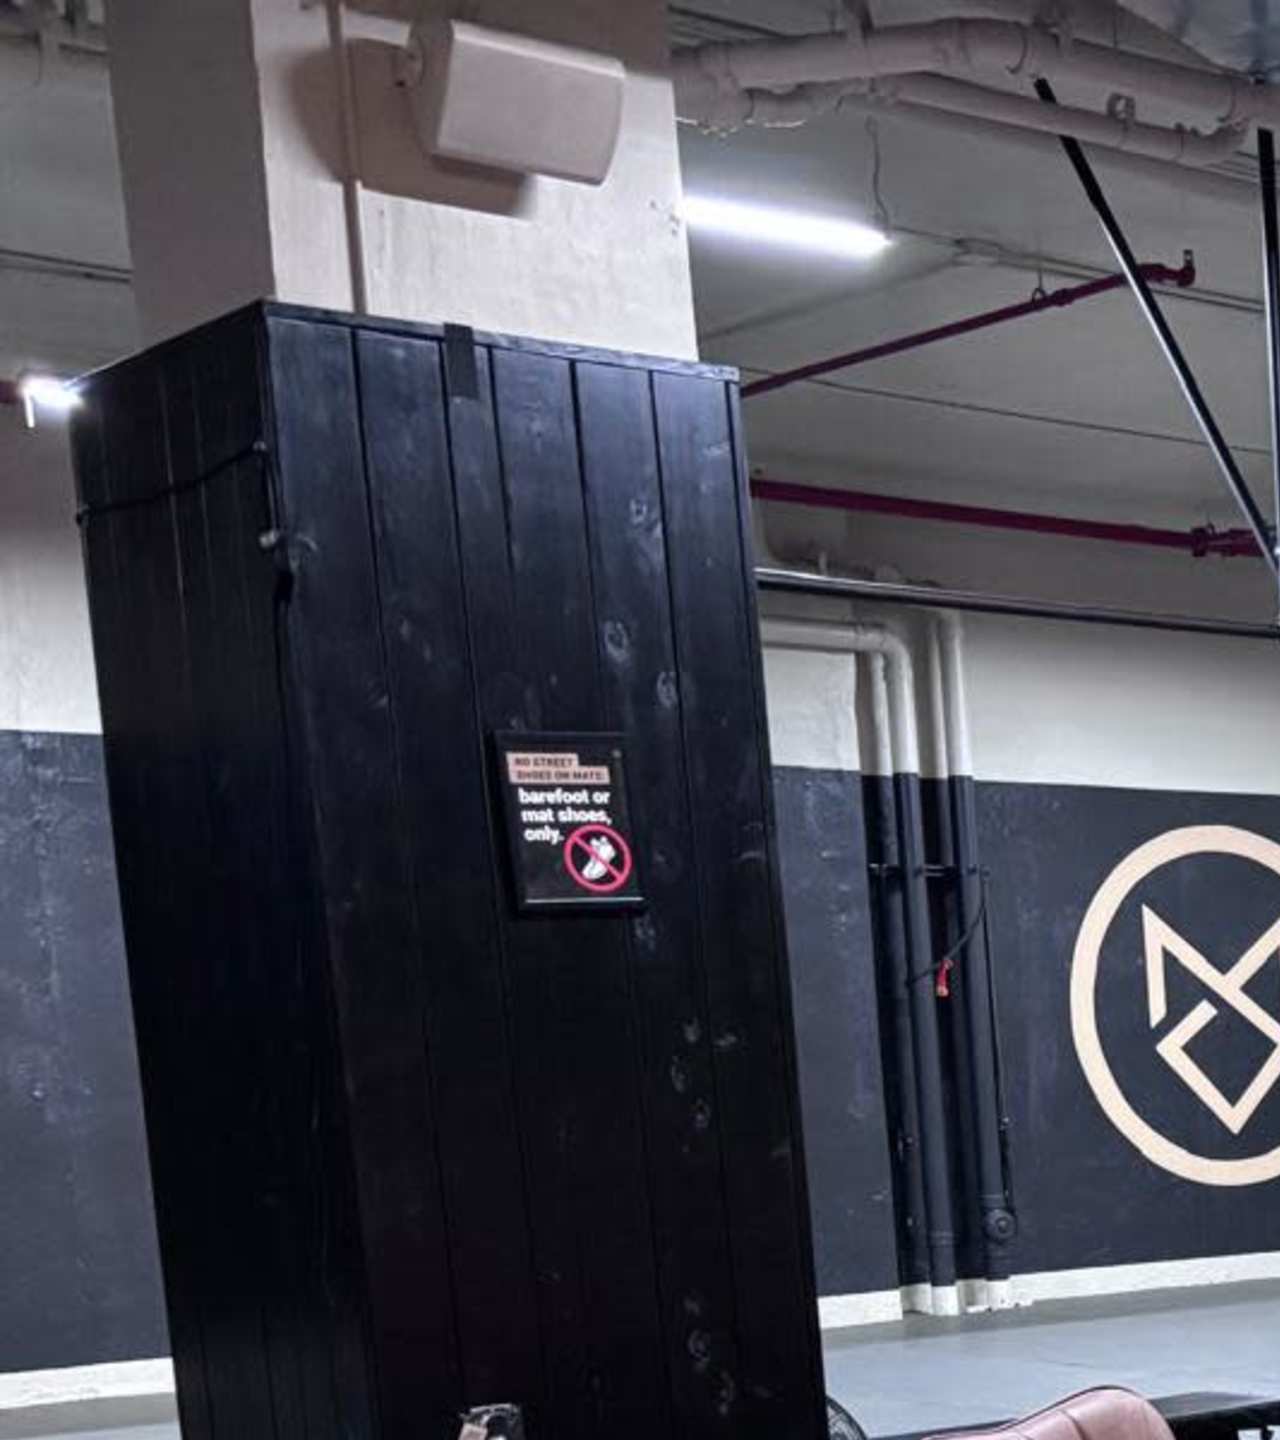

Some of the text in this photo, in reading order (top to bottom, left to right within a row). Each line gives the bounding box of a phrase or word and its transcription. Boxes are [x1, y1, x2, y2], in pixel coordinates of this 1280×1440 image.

[533, 758, 573, 767] STREET
[518, 787, 611, 804] barefoot or
[521, 806, 612, 826] mat shoes,
[524, 825, 565, 845] only.
